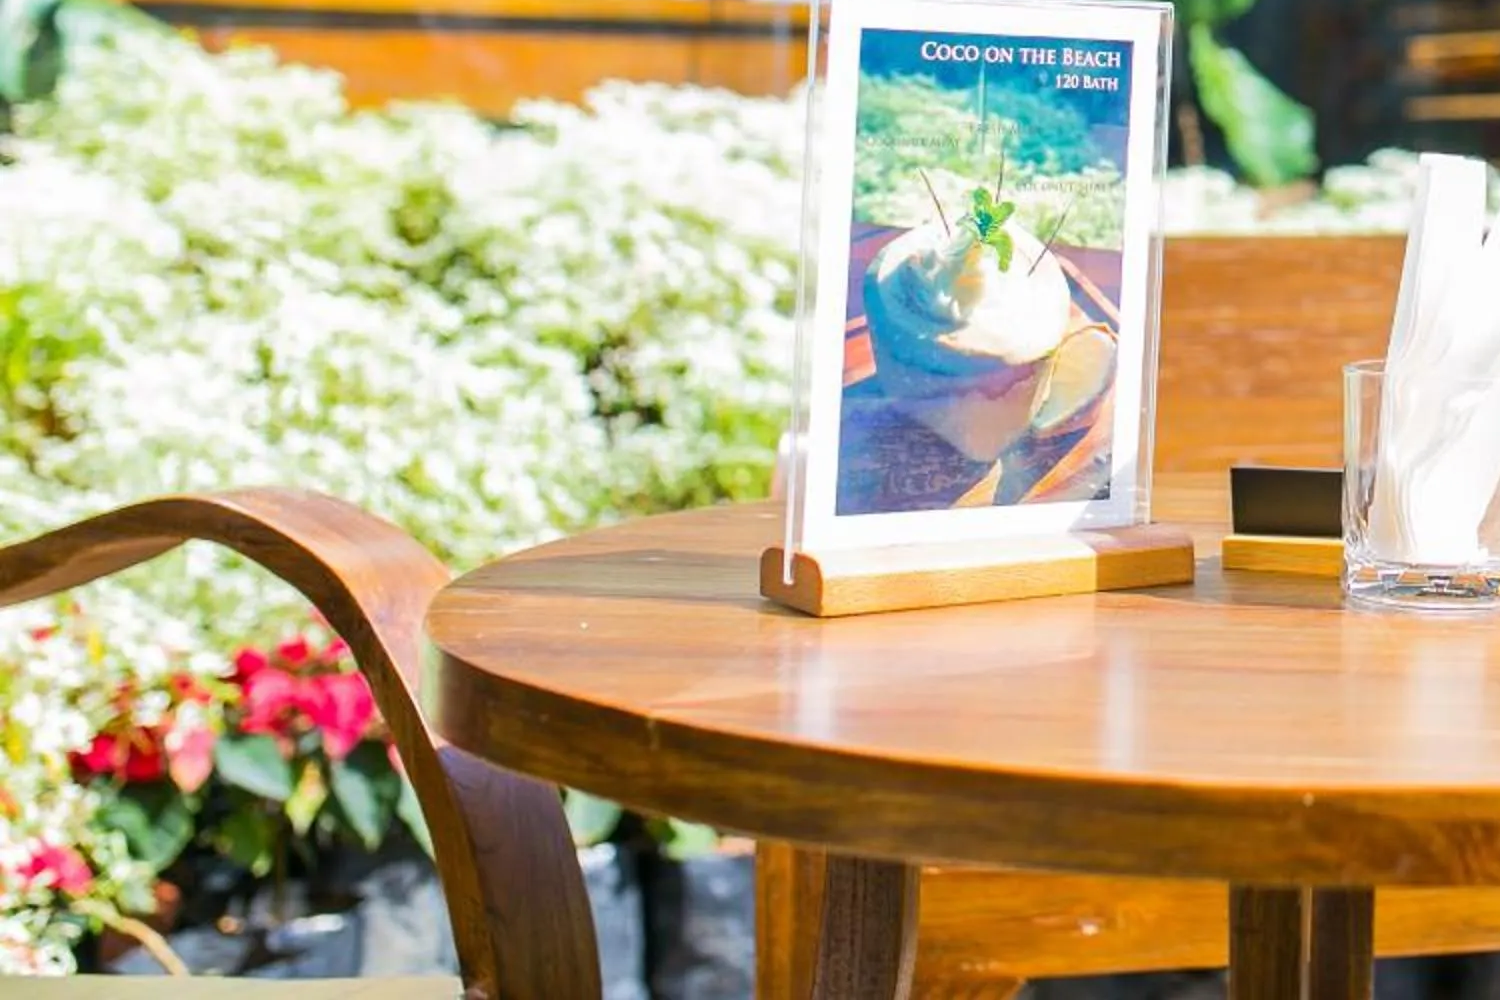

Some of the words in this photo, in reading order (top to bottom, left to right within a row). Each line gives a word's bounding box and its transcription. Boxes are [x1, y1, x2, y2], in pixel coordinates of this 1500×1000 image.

[921, 41, 979, 61] COCO
[984, 47, 1013, 64] ON
[1020, 47, 1057, 65] THE
[1062, 48, 1121, 68] BEACH
[1055, 74, 1079, 89] 120
